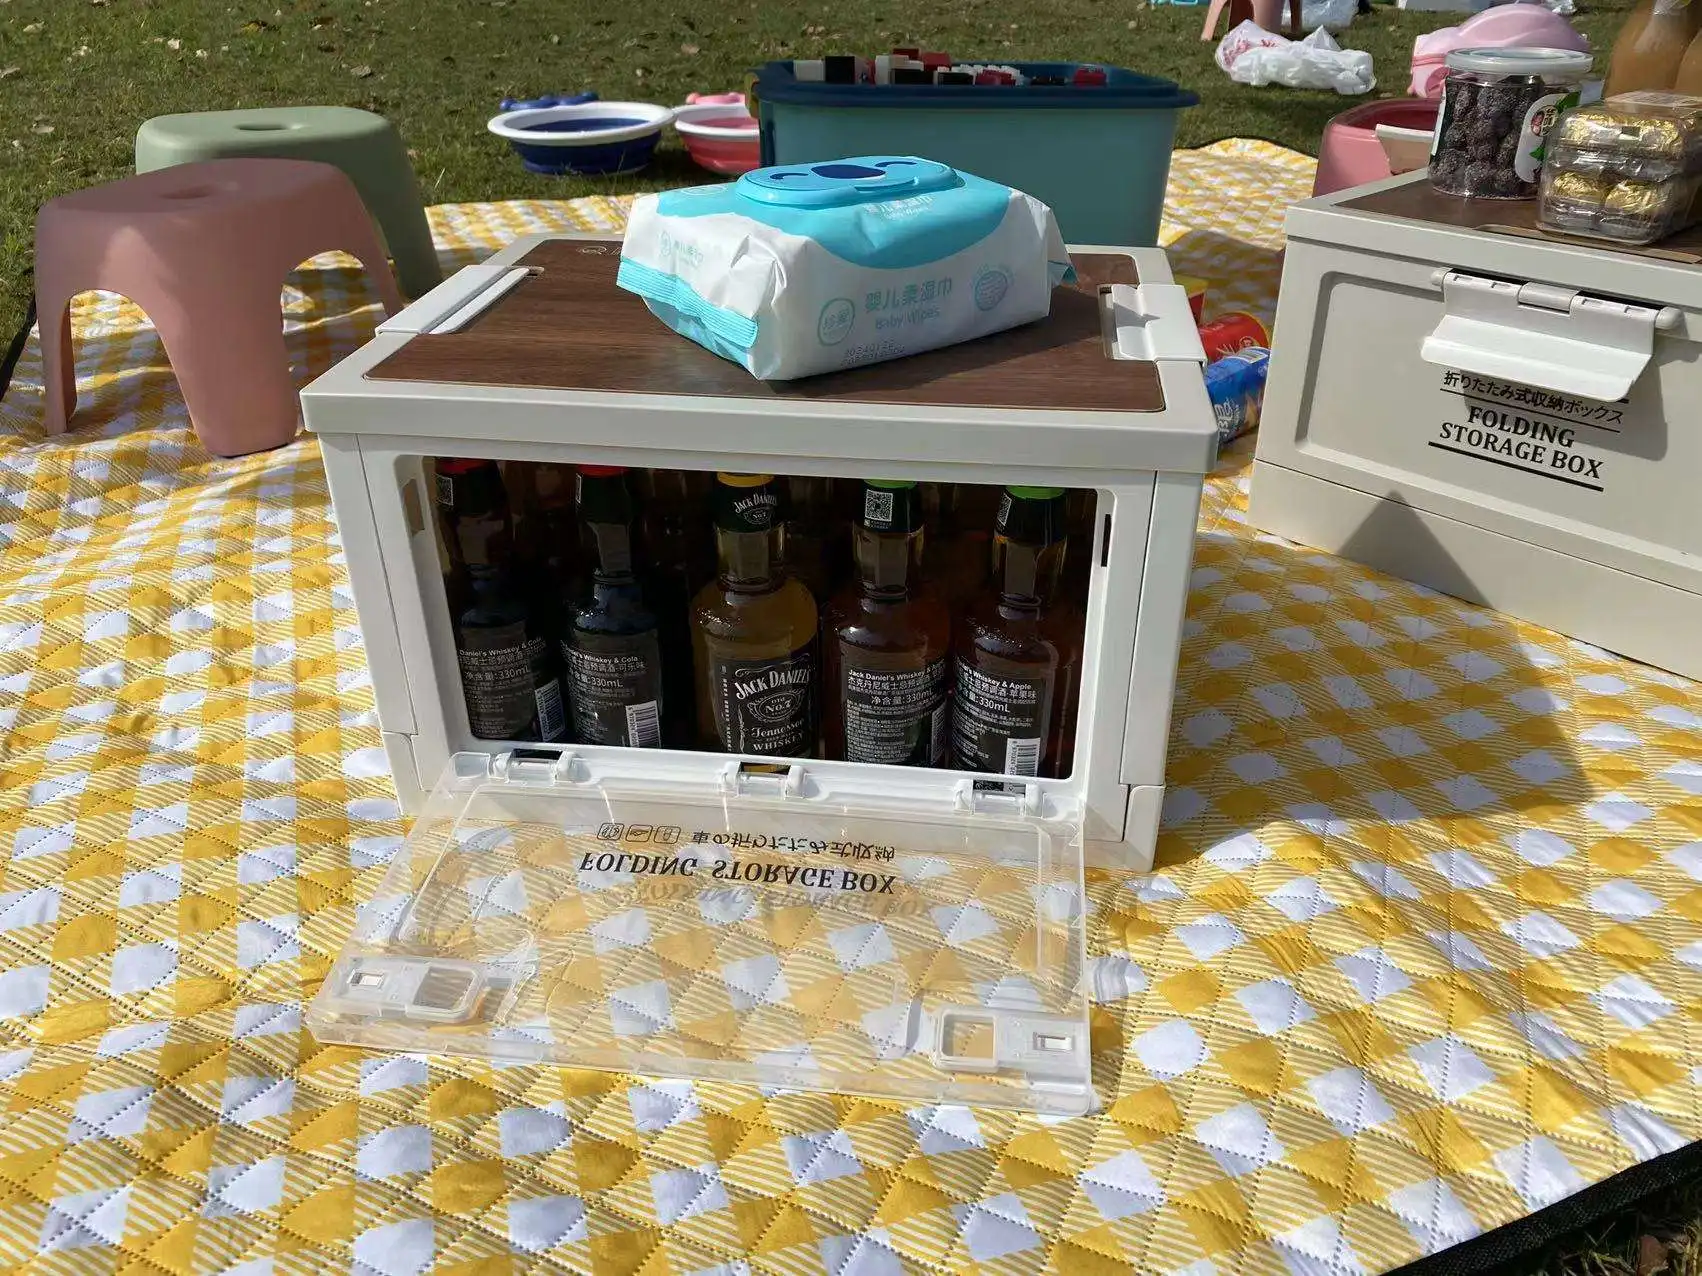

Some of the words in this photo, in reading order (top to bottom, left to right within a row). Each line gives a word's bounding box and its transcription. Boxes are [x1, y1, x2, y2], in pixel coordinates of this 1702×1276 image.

[866, 277, 953, 314] 婴儿柔湿巾
[905, 306, 941, 325] Wipes
[1443, 370, 1624, 425] 折りたたみ式収納ボックス
[1467, 405, 1576, 449] FOLDING
[1439, 422, 1546, 465] STORAGE
[1550, 452, 1604, 480] BOX
[488, 646, 519, 657] Whiskey
[583, 653, 611, 665] Whiskey
[848, 669, 864, 677] Jack
[865, 672, 895, 682] Daniel's
[897, 670, 925, 681] Whiskey
[972, 672, 1001, 688] Whiskey
[1002, 680, 1007, 688] &
[1009, 682, 1032, 691] Apple
[734, 677, 769, 700] JACK
